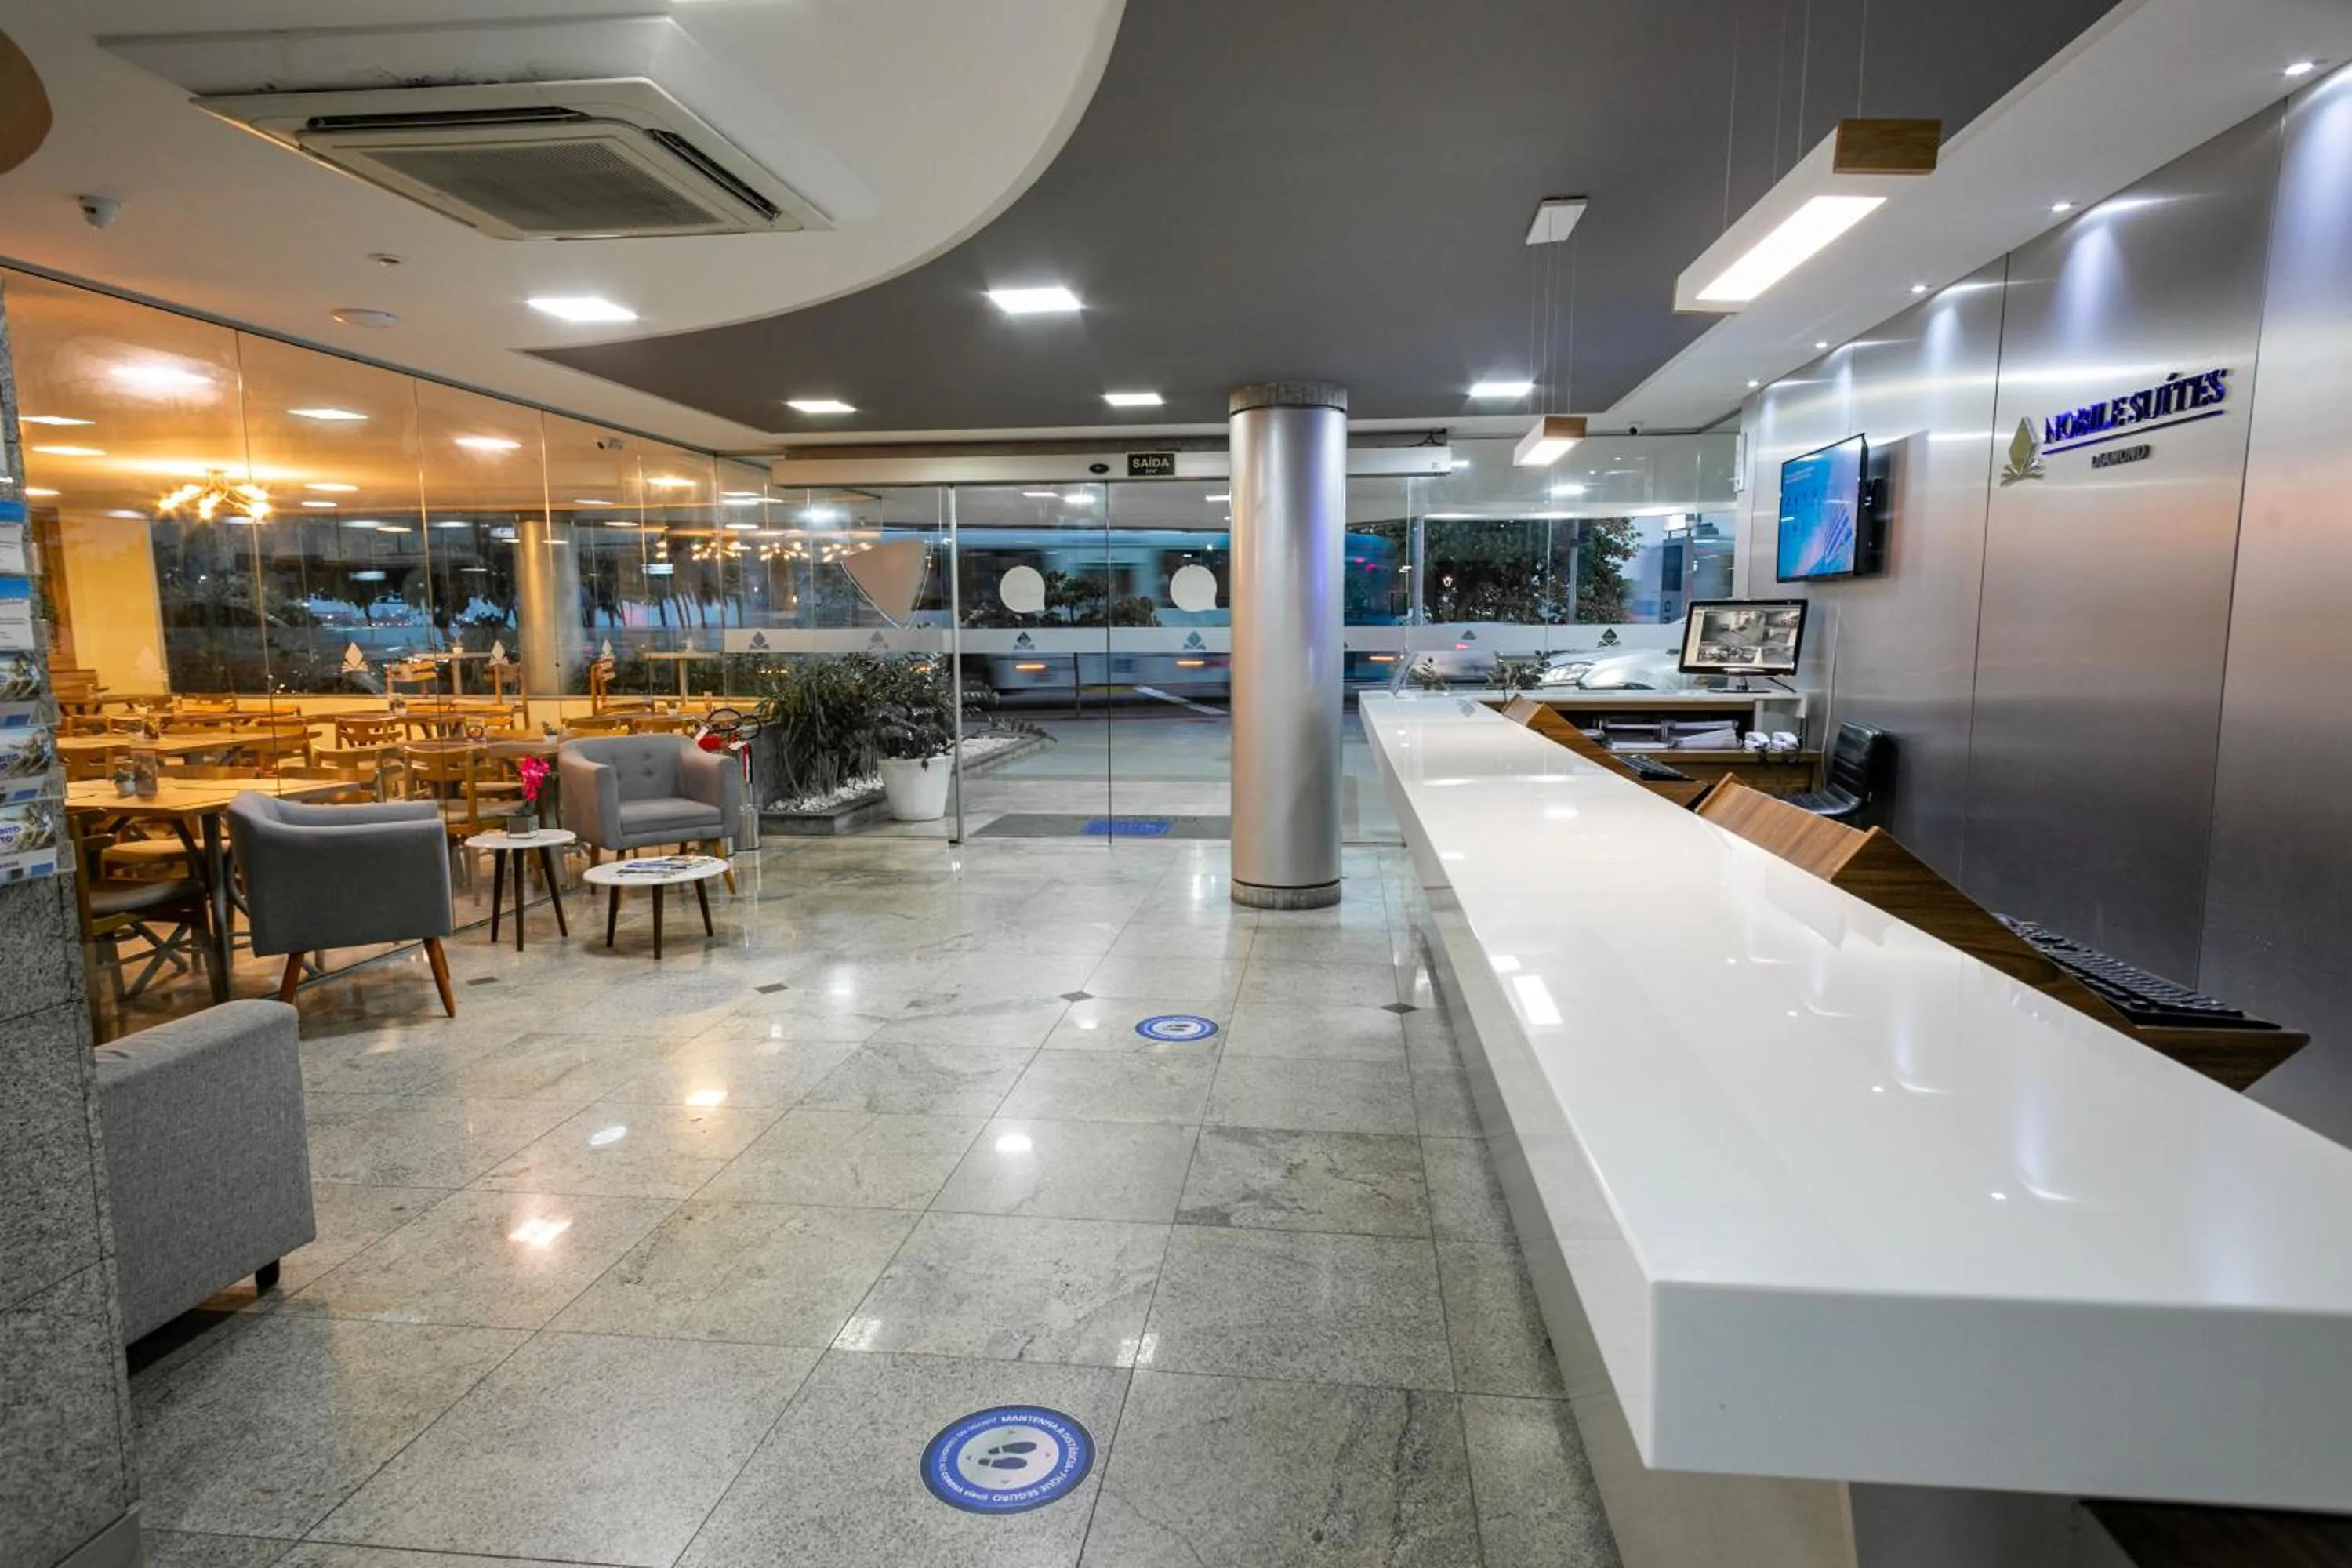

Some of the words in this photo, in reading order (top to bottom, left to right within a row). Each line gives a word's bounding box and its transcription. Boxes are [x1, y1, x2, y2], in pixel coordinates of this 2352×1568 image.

[1132, 456, 1170, 468] SAÍDA
[2092, 444, 2151, 468] DIAMOND
[1001, 1414, 1059, 1430] MANTENHA
[993, 1490, 1039, 1502] SEGURO
